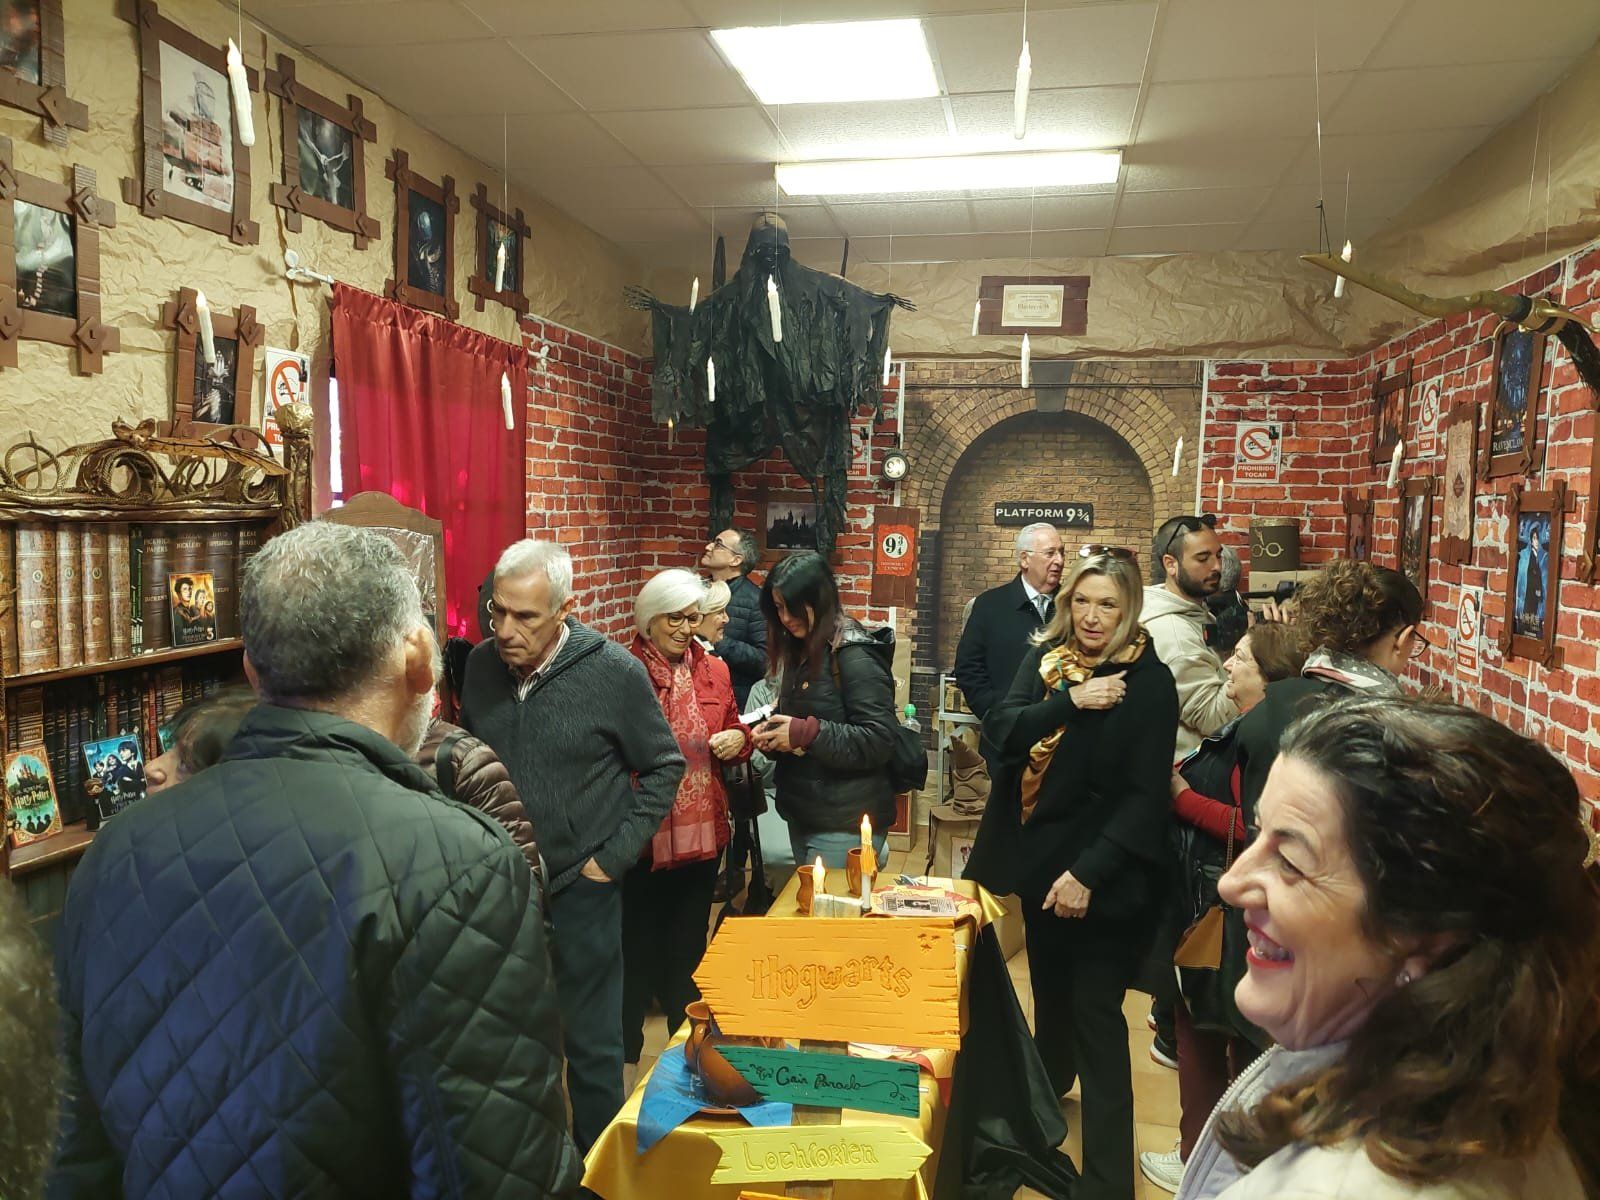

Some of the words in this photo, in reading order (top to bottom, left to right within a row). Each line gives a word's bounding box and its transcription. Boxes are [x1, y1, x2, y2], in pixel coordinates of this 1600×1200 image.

[995, 508, 1064, 518] PLATFORM
[746, 954, 912, 1009] Hogwarts
[776, 1066, 808, 1086] Cair
